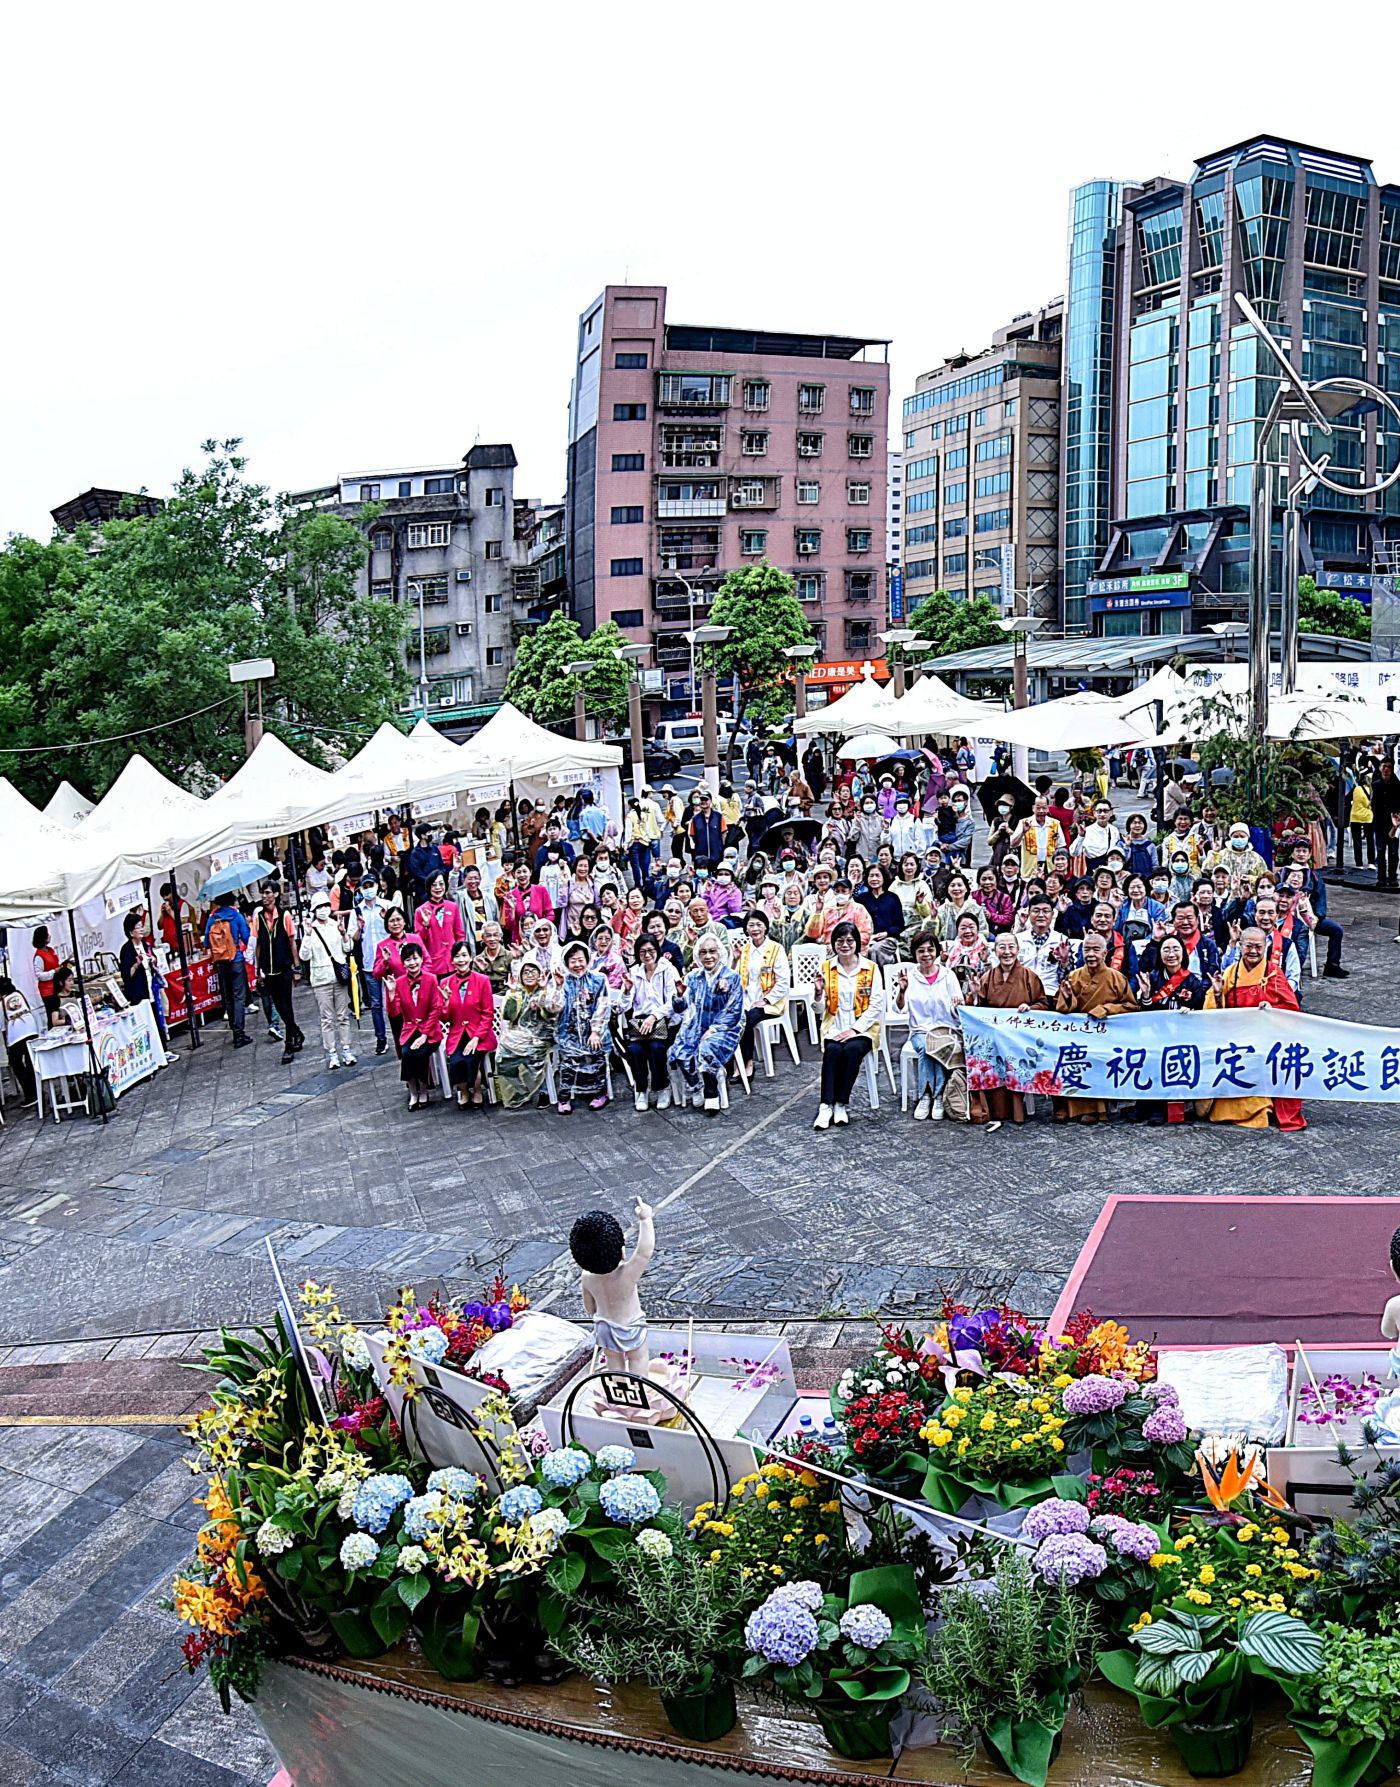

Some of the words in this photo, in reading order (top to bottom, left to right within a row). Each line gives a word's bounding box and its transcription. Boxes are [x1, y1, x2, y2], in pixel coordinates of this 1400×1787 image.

[1172, 575, 1183, 586] 3F
[827, 665, 855, 677] 康是美
[1006, 1015, 1108, 1034] 佛光山台北道場
